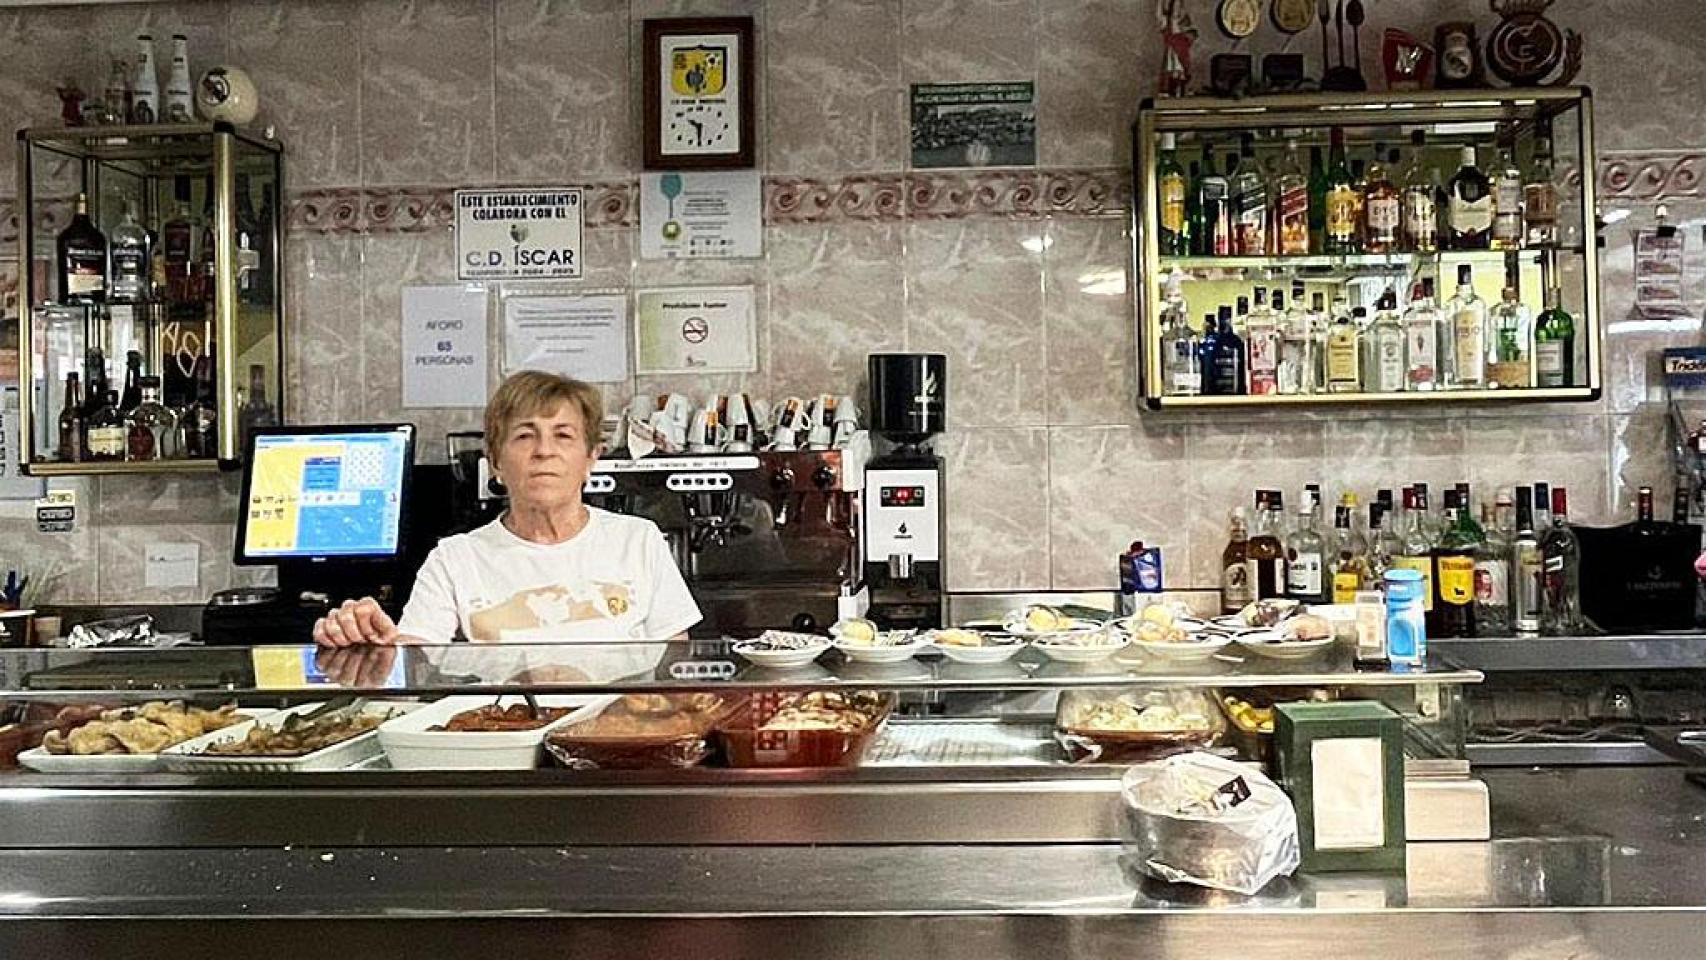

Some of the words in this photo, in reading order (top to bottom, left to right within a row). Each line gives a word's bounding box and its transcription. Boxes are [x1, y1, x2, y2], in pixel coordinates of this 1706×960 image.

[461, 195, 483, 207] ESTE
[487, 194, 578, 206] ESTABLECIMIENTO
[473, 208, 527, 220] COLABORA
[531, 207, 552, 219] CON
[555, 207, 566, 219] EL
[466, 251, 506, 267] C.D.
[514, 244, 574, 266] ÍSCAR
[426, 320, 463, 331] AFORO
[415, 355, 473, 366] PERSONAS
